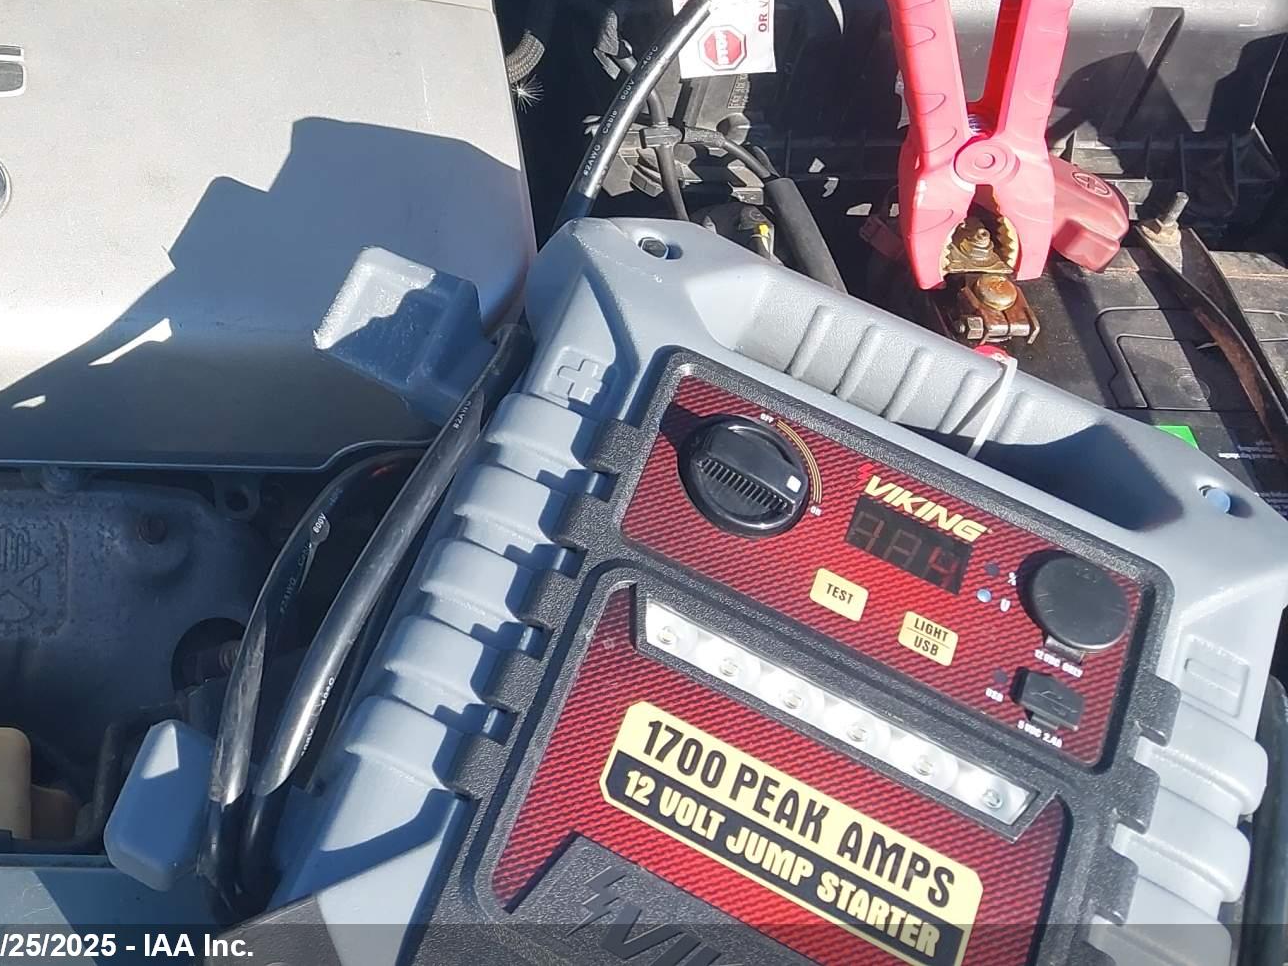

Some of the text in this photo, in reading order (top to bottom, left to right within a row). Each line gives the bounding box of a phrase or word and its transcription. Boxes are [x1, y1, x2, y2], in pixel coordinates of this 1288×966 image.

[757, 12, 769, 33] OR
[602, 110, 618, 135] Cable
[760, 413, 775, 424] OFF
[863, 475, 988, 543] VIKING
[312, 512, 328, 535] 600V
[826, 583, 854, 605] TEST
[914, 617, 949, 642] LIGHT
[913, 636, 939, 656] USB
[643, 720, 955, 908] 1700 PEAK AMPS
[623, 769, 941, 957] 12 VOLT JUMP STARTER
